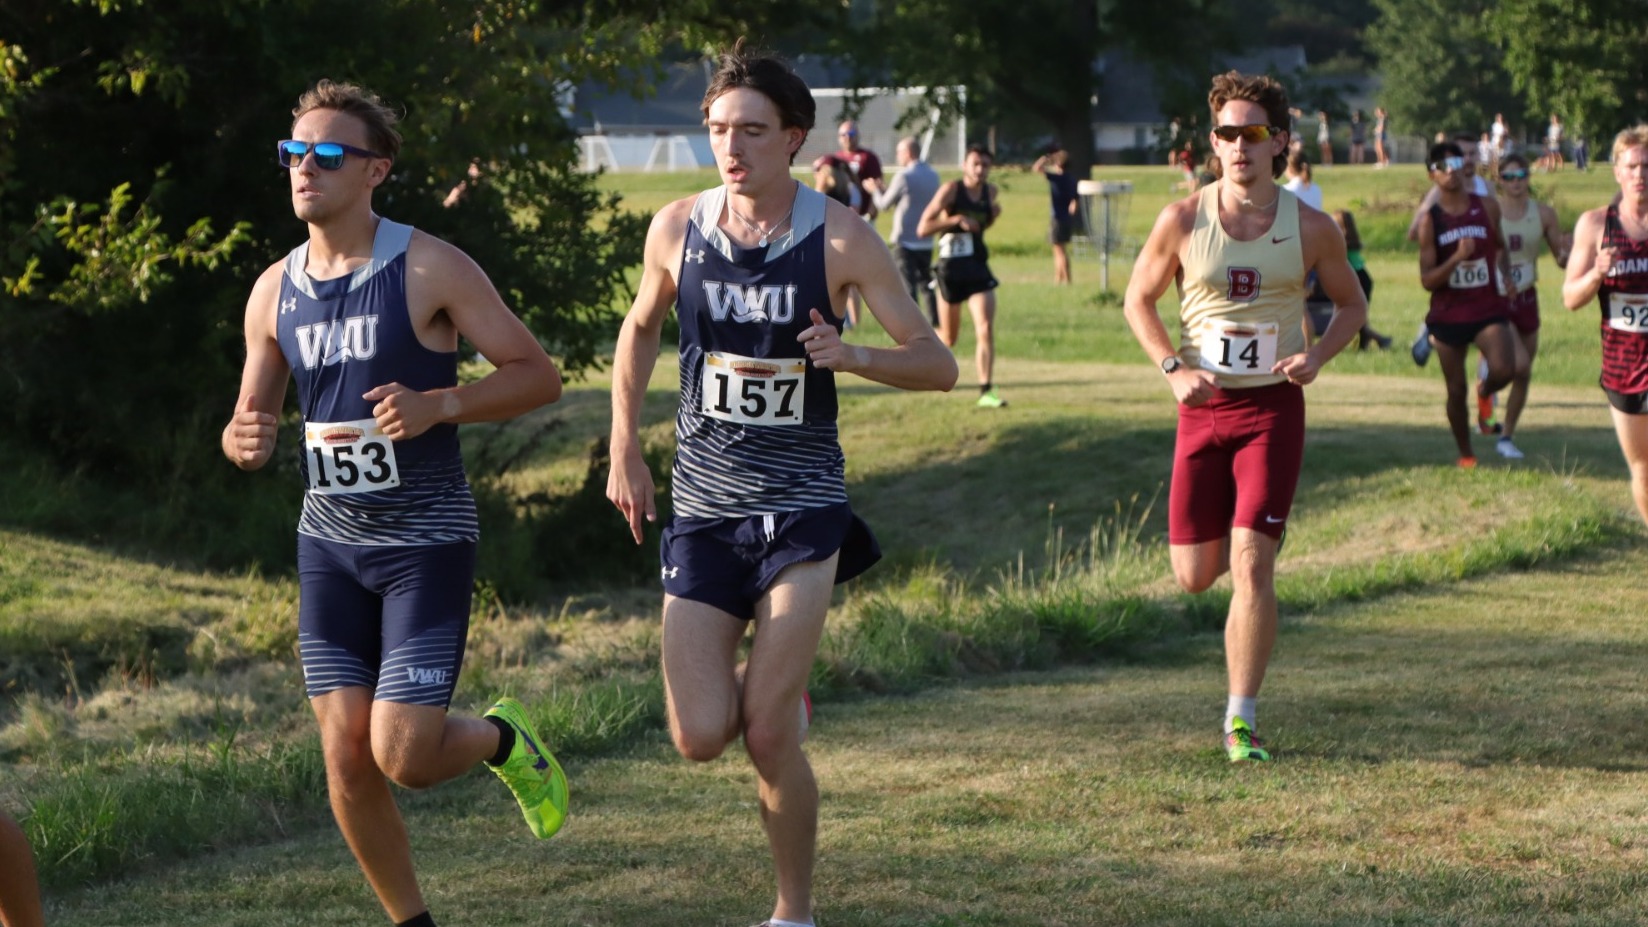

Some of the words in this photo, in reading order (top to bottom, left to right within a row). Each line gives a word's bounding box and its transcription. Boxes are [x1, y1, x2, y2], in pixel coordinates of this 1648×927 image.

[1454, 267, 1487, 284] 106
[703, 280, 797, 324] VWU
[296, 314, 379, 370] VWU
[1219, 338, 1260, 369] 14
[714, 373, 799, 418] 157
[312, 442, 391, 487] 153
[406, 666, 447, 685] VWU
